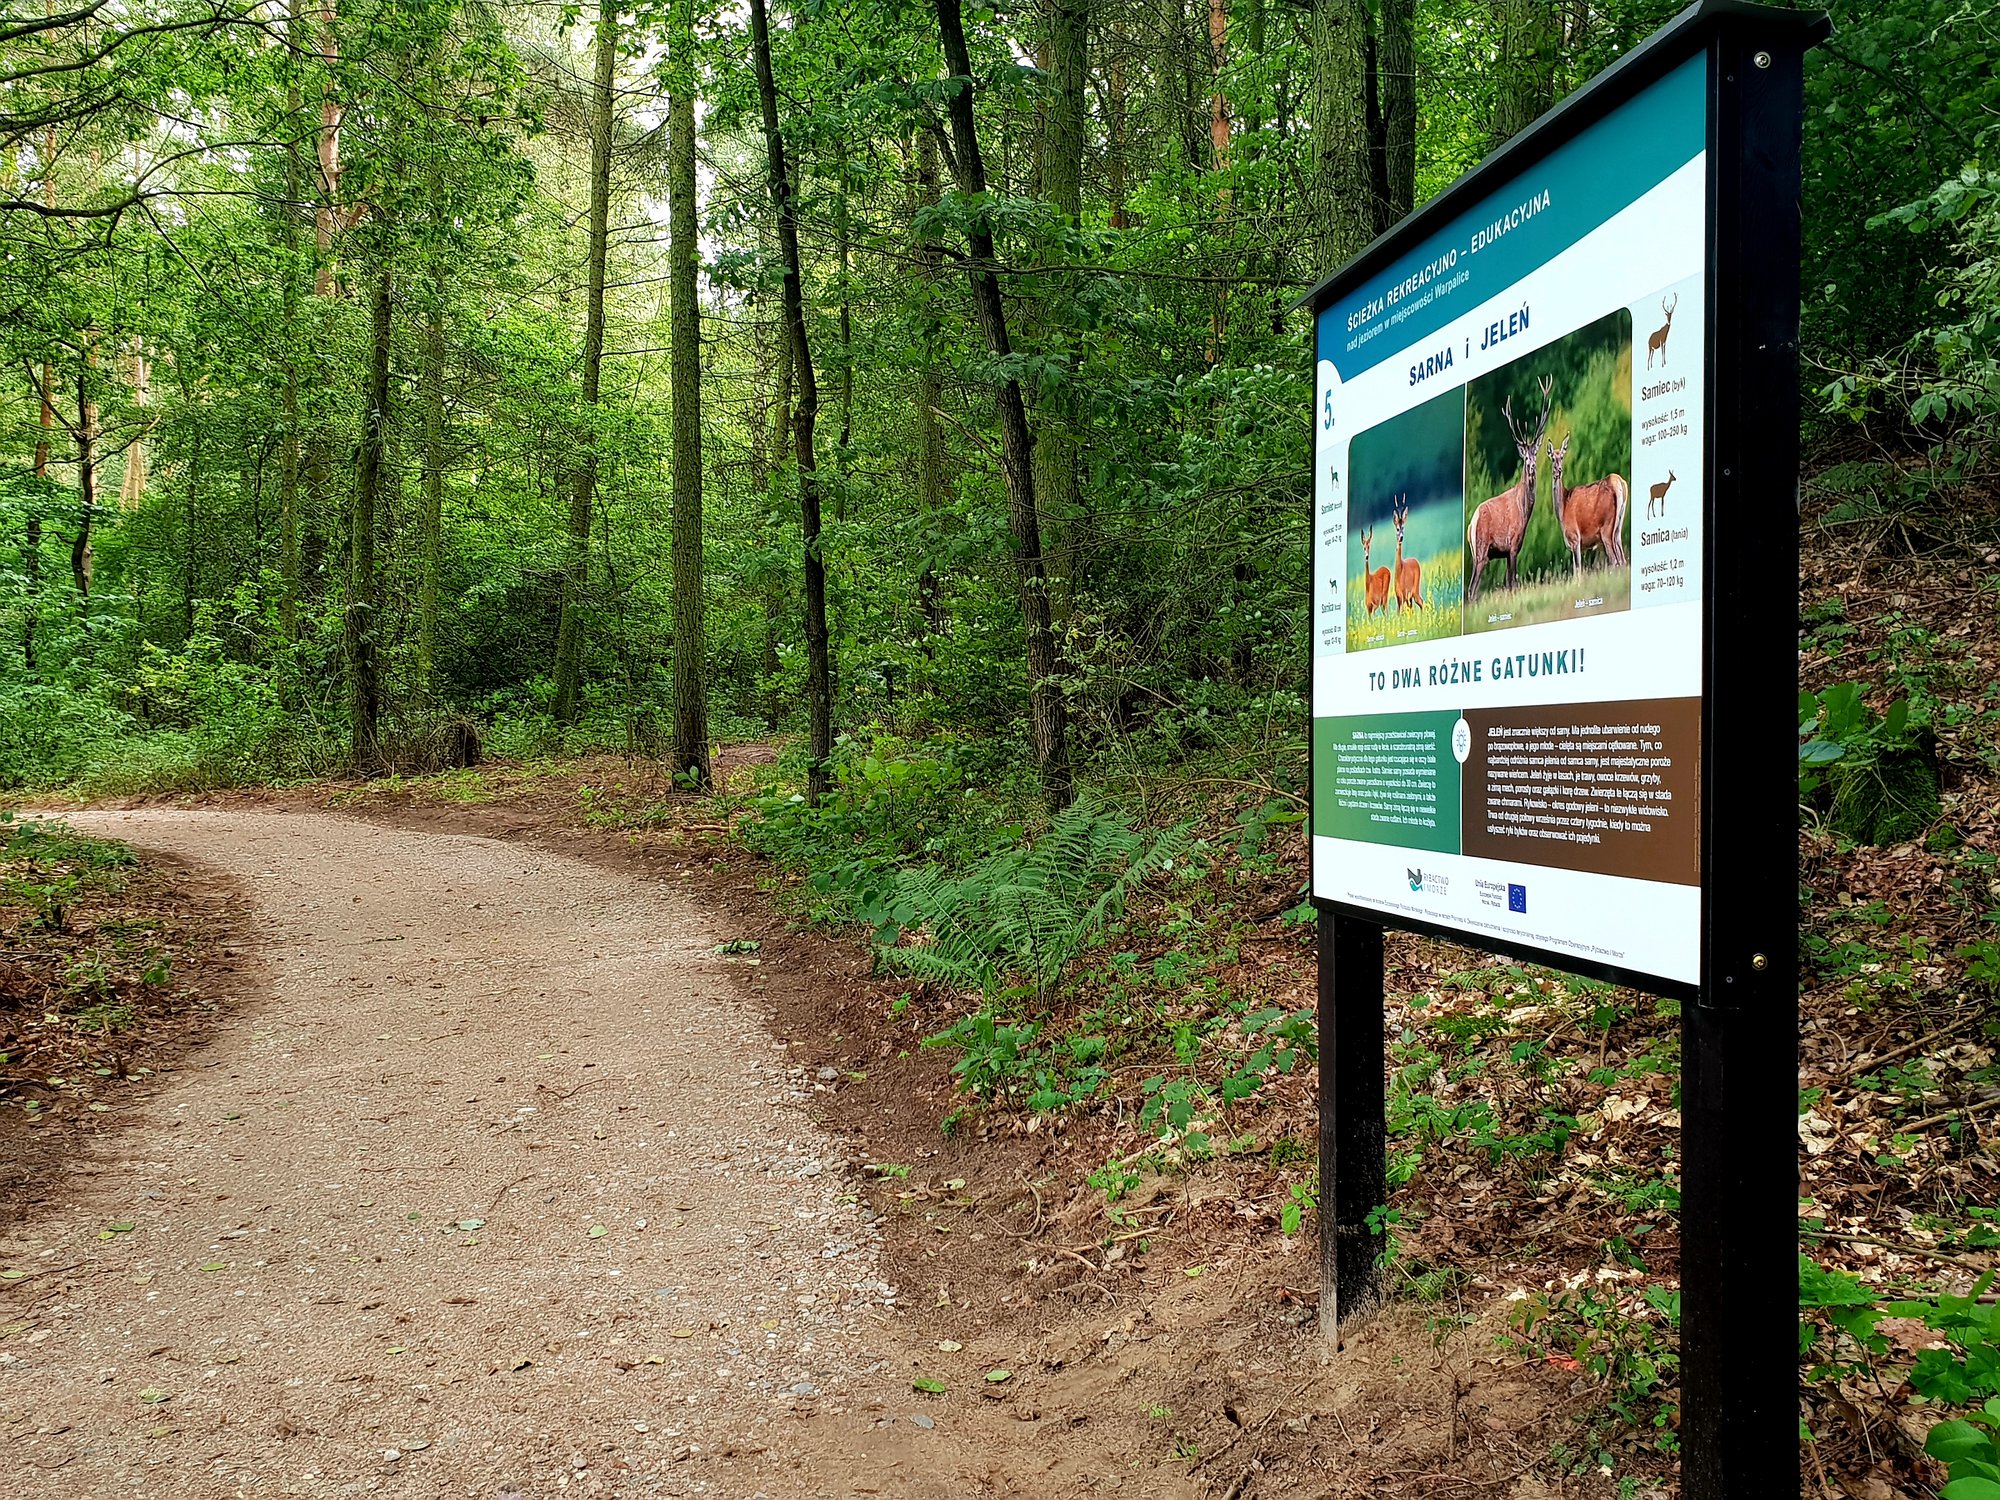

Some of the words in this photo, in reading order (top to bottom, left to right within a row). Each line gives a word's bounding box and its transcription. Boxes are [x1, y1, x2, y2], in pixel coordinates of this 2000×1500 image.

[1347, 297, 1384, 332] ŚCIEŻKA
[1387, 249, 1457, 307] REKREACYJNO
[1471, 188, 1550, 254] EDUKACYJNA
[1346, 336, 1357, 352] nad
[1358, 323, 1383, 349] jeziorem
[1384, 317, 1390, 329] w
[1391, 292, 1433, 327] miejscowości
[1434, 269, 1470, 299] Warpalice
[1409, 347, 1453, 386] SARNA
[1465, 338, 1469, 358] i
[1481, 301, 1530, 350] JELEŃ
[1325, 389, 1335, 430] 5.
[1641, 380, 1671, 401] Samiec
[1671, 377, 1686, 393] (byk)
[1641, 528, 1670, 546] Samica
[1369, 671, 1385, 691] TO
[1392, 667, 1421, 689] DWA
[1429, 658, 1482, 686] RÓŻNE
[1492, 648, 1585, 681] GATUNKI!
